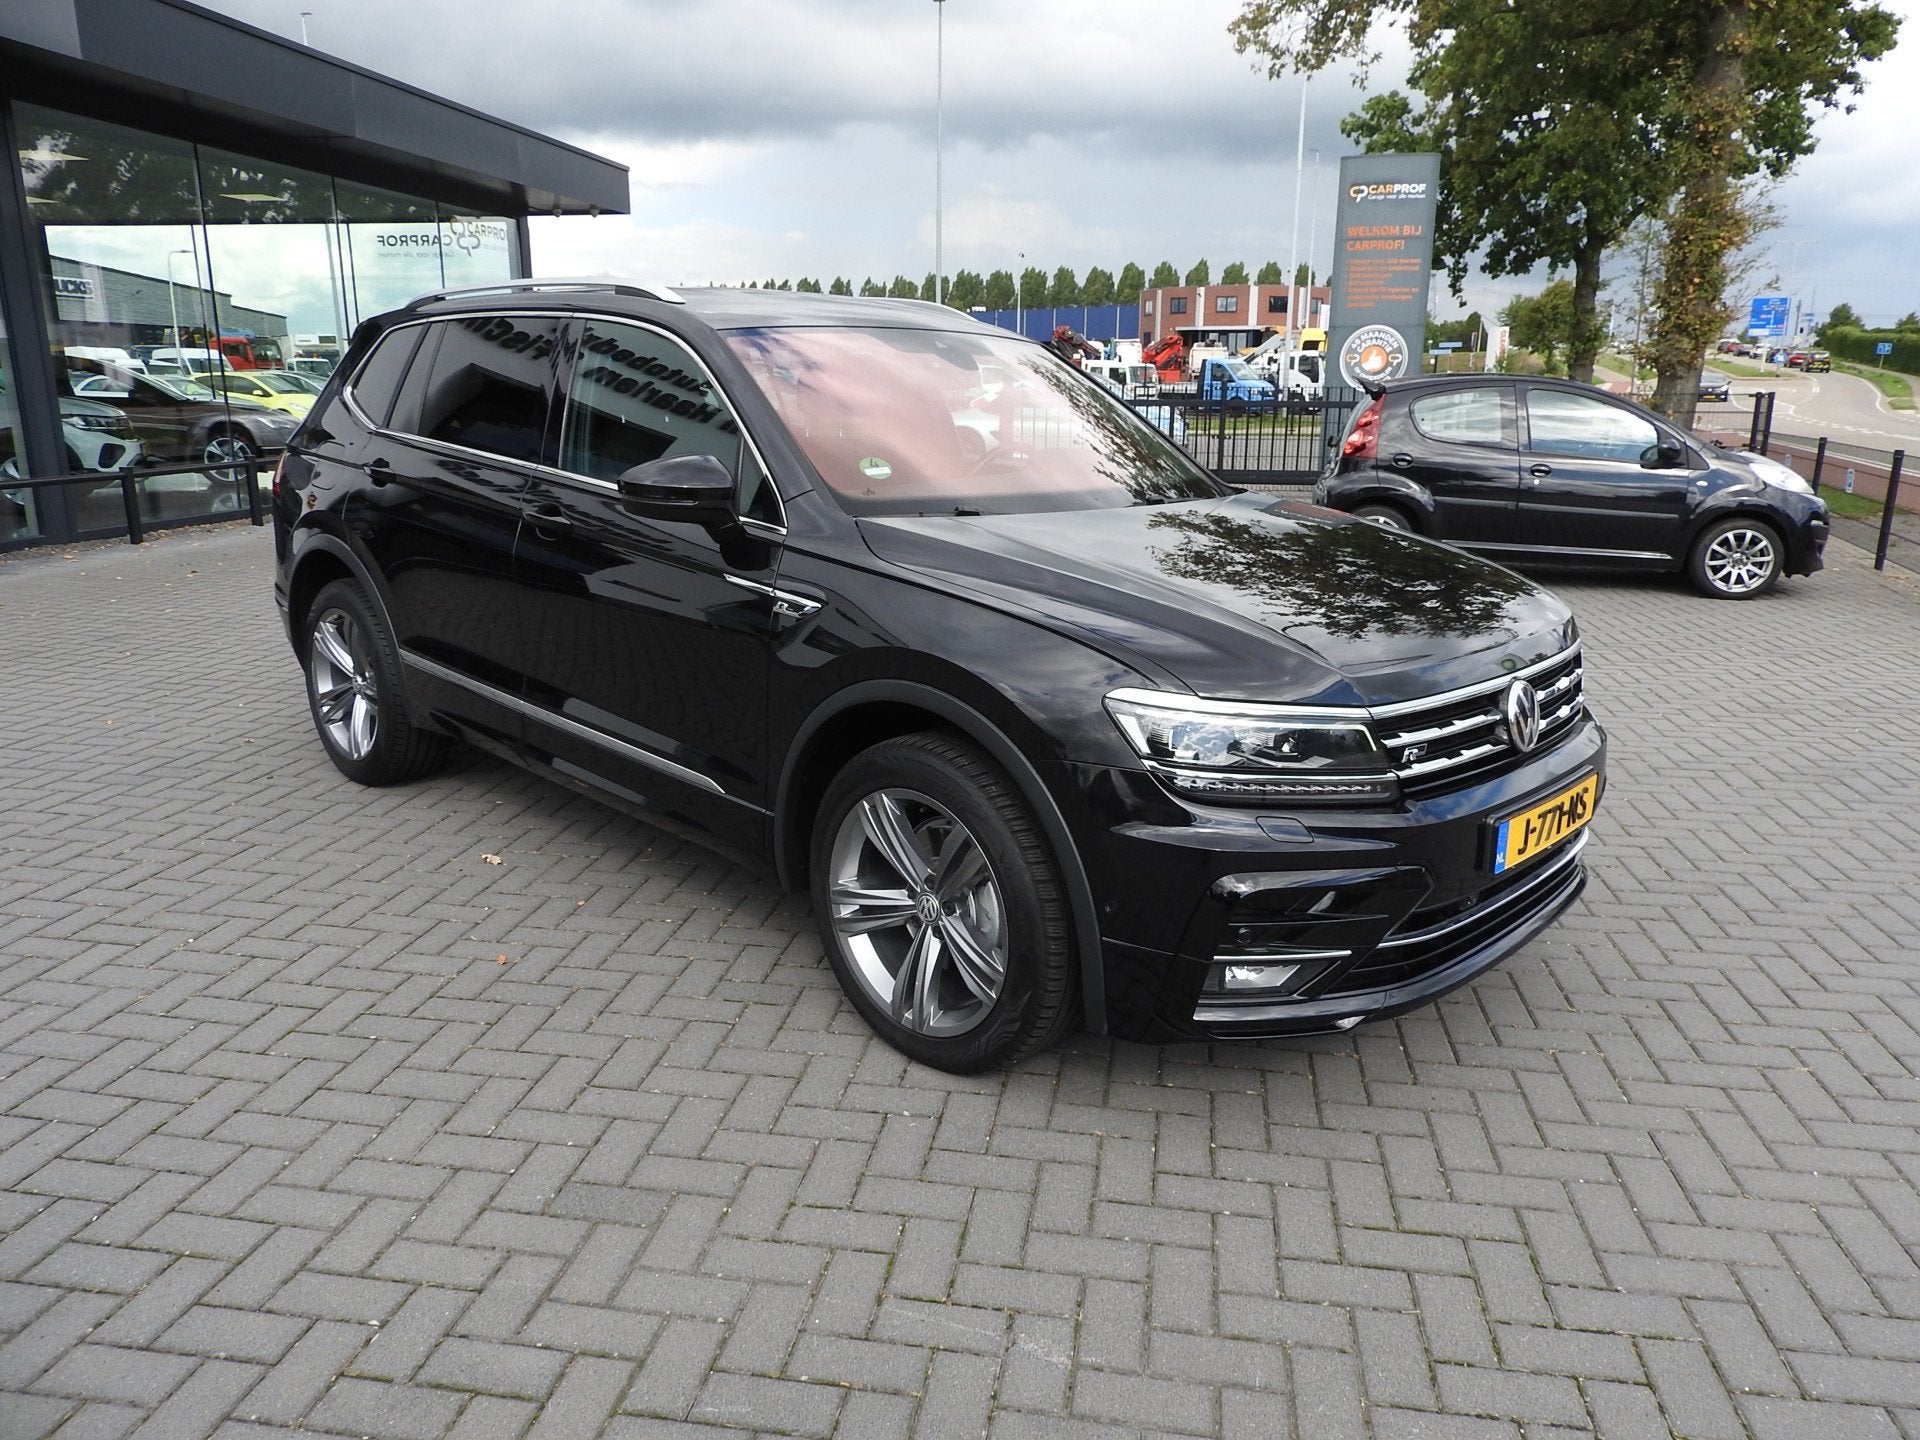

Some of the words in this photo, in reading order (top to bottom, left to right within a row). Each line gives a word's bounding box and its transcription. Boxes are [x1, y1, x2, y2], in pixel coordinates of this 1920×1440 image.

[1368, 183, 1427, 194] CARPROF
[1347, 226, 1400, 236] WELKOM
[1402, 225, 1422, 235] BIJ
[1346, 240, 1405, 251] CARPROF!
[1360, 331, 1400, 349] MAANDEN
[1496, 852, 1504, 865] NL
